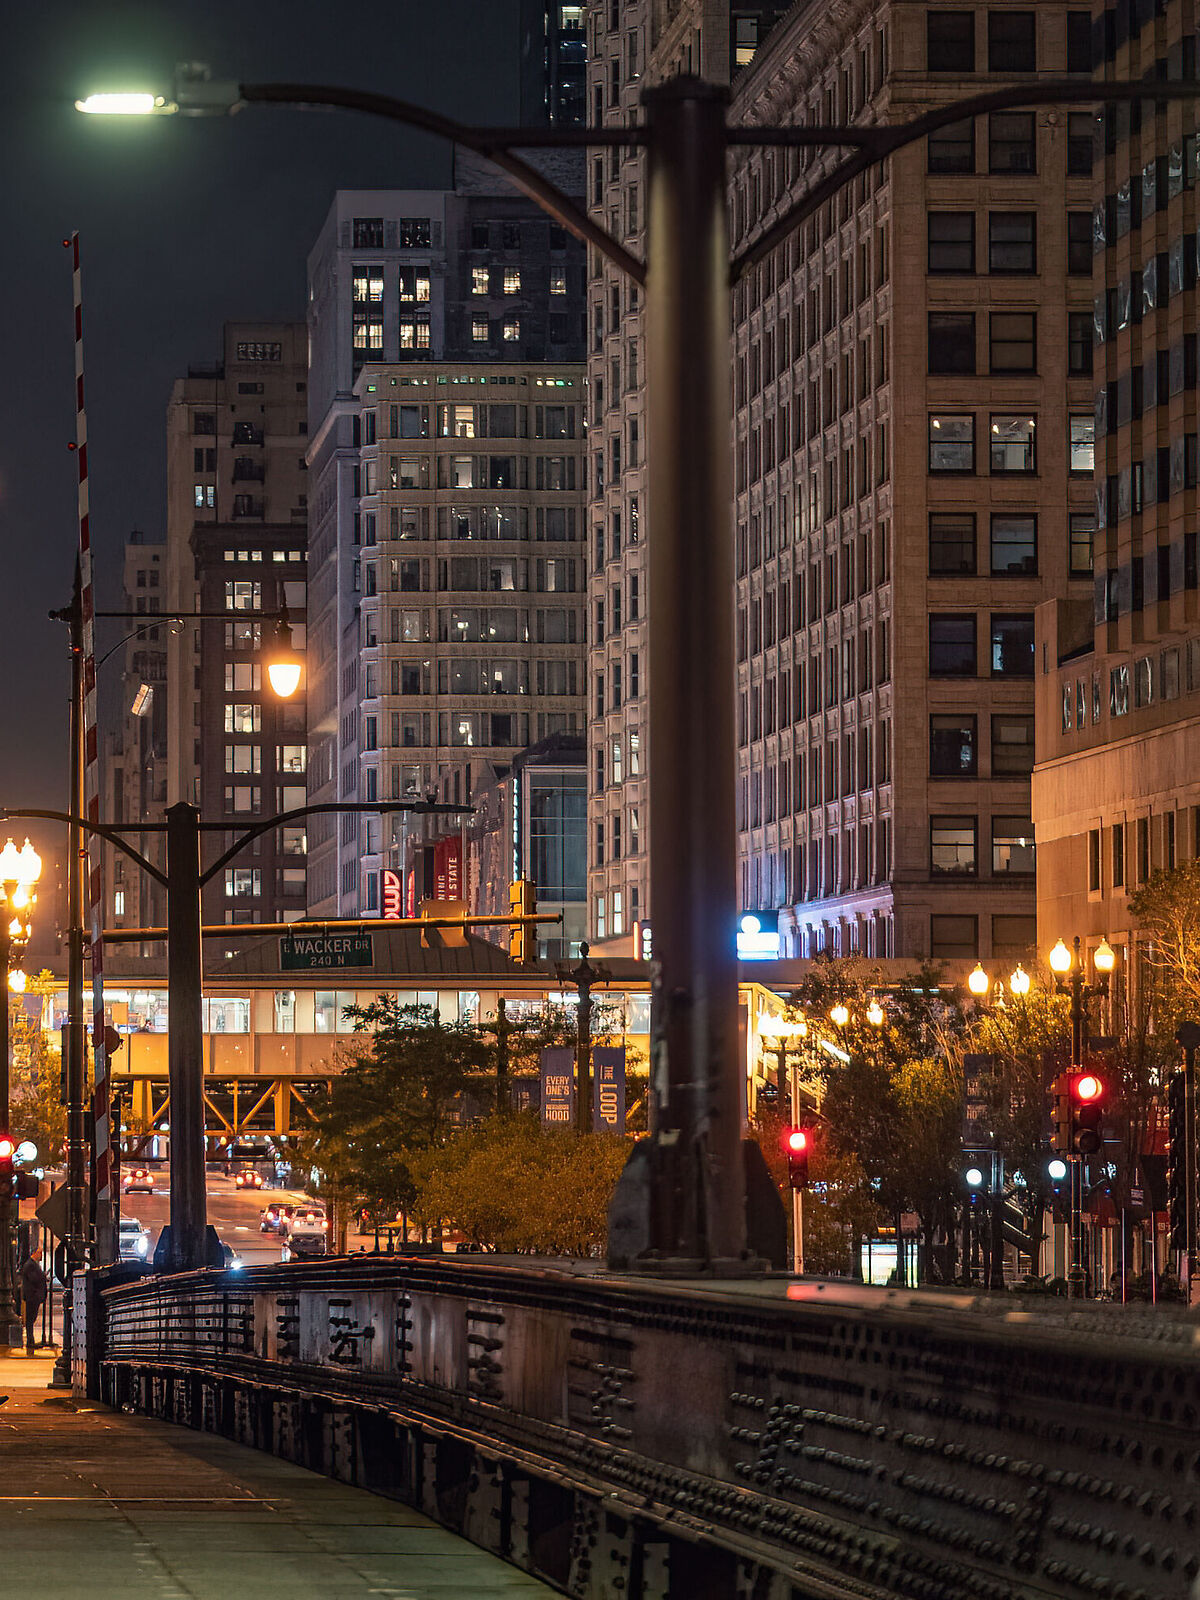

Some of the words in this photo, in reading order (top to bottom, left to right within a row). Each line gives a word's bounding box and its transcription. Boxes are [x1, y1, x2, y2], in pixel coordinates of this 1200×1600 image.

[448, 857, 457, 890] STATE
[294, 939, 351, 954] WACKER
[355, 939, 369, 950] DR
[310, 956, 332, 966] 240
[337, 955, 345, 965] N
[604, 1065, 614, 1080] THE
[546, 1075, 570, 1085] EVERY
[546, 1085, 570, 1096] ONE'S
[600, 1083, 618, 1124] LOOP
[546, 1110, 570, 1121] HOOD
